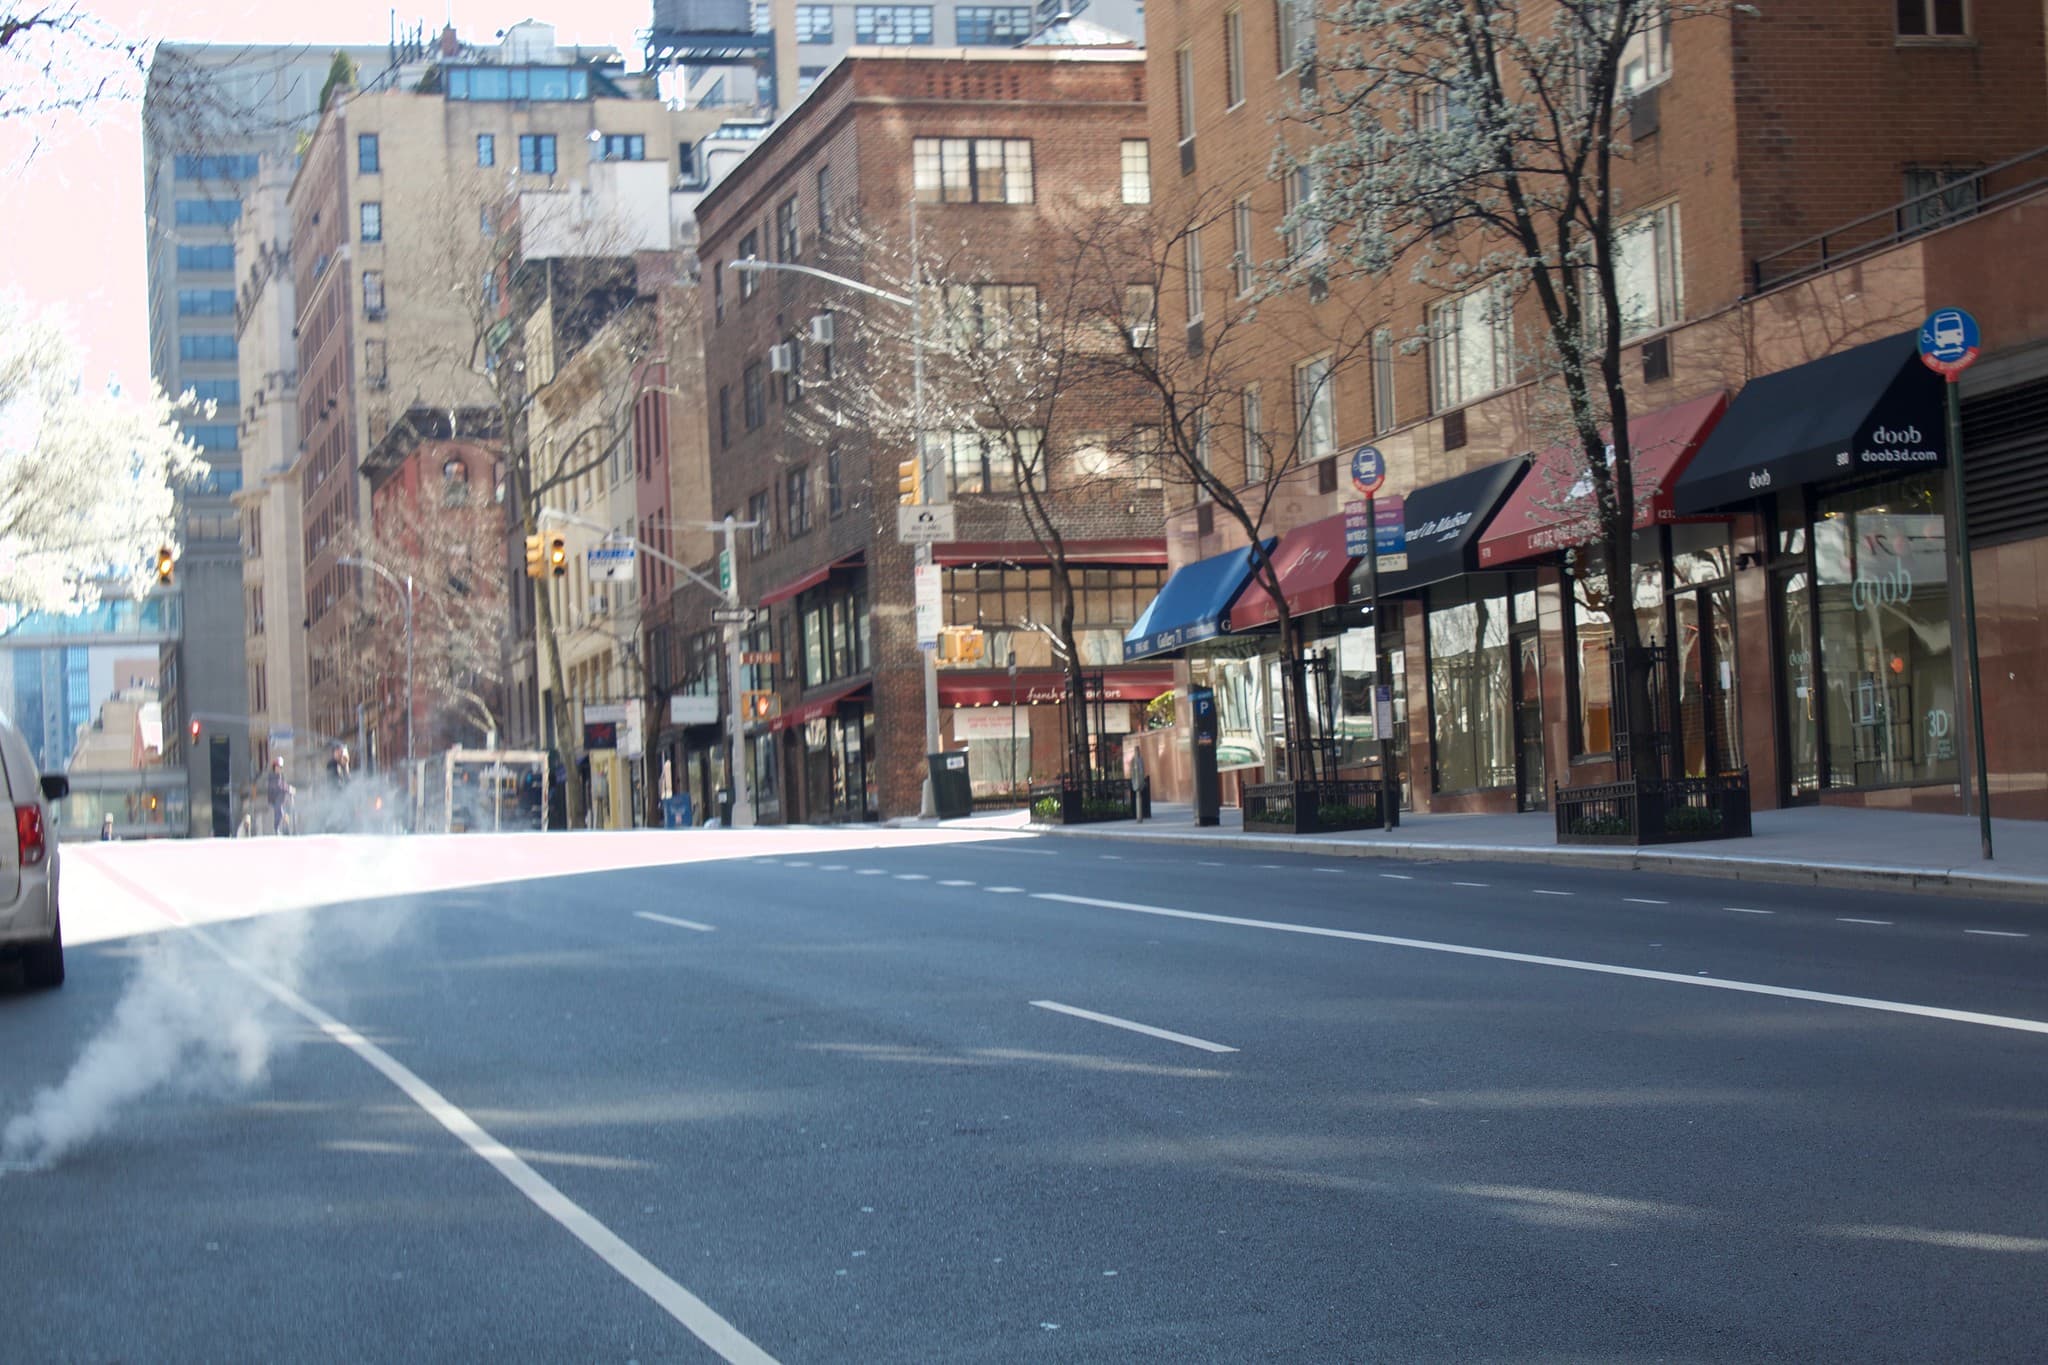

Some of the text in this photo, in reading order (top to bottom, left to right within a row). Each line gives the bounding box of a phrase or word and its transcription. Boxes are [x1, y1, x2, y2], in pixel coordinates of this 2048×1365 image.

[1873, 426, 1922, 443] doob
[1861, 449, 1938, 462] doob3d.com
[1749, 469, 1771, 488] doob
[1852, 556, 1912, 611] doob
[1928, 709, 1948, 737] 3D
